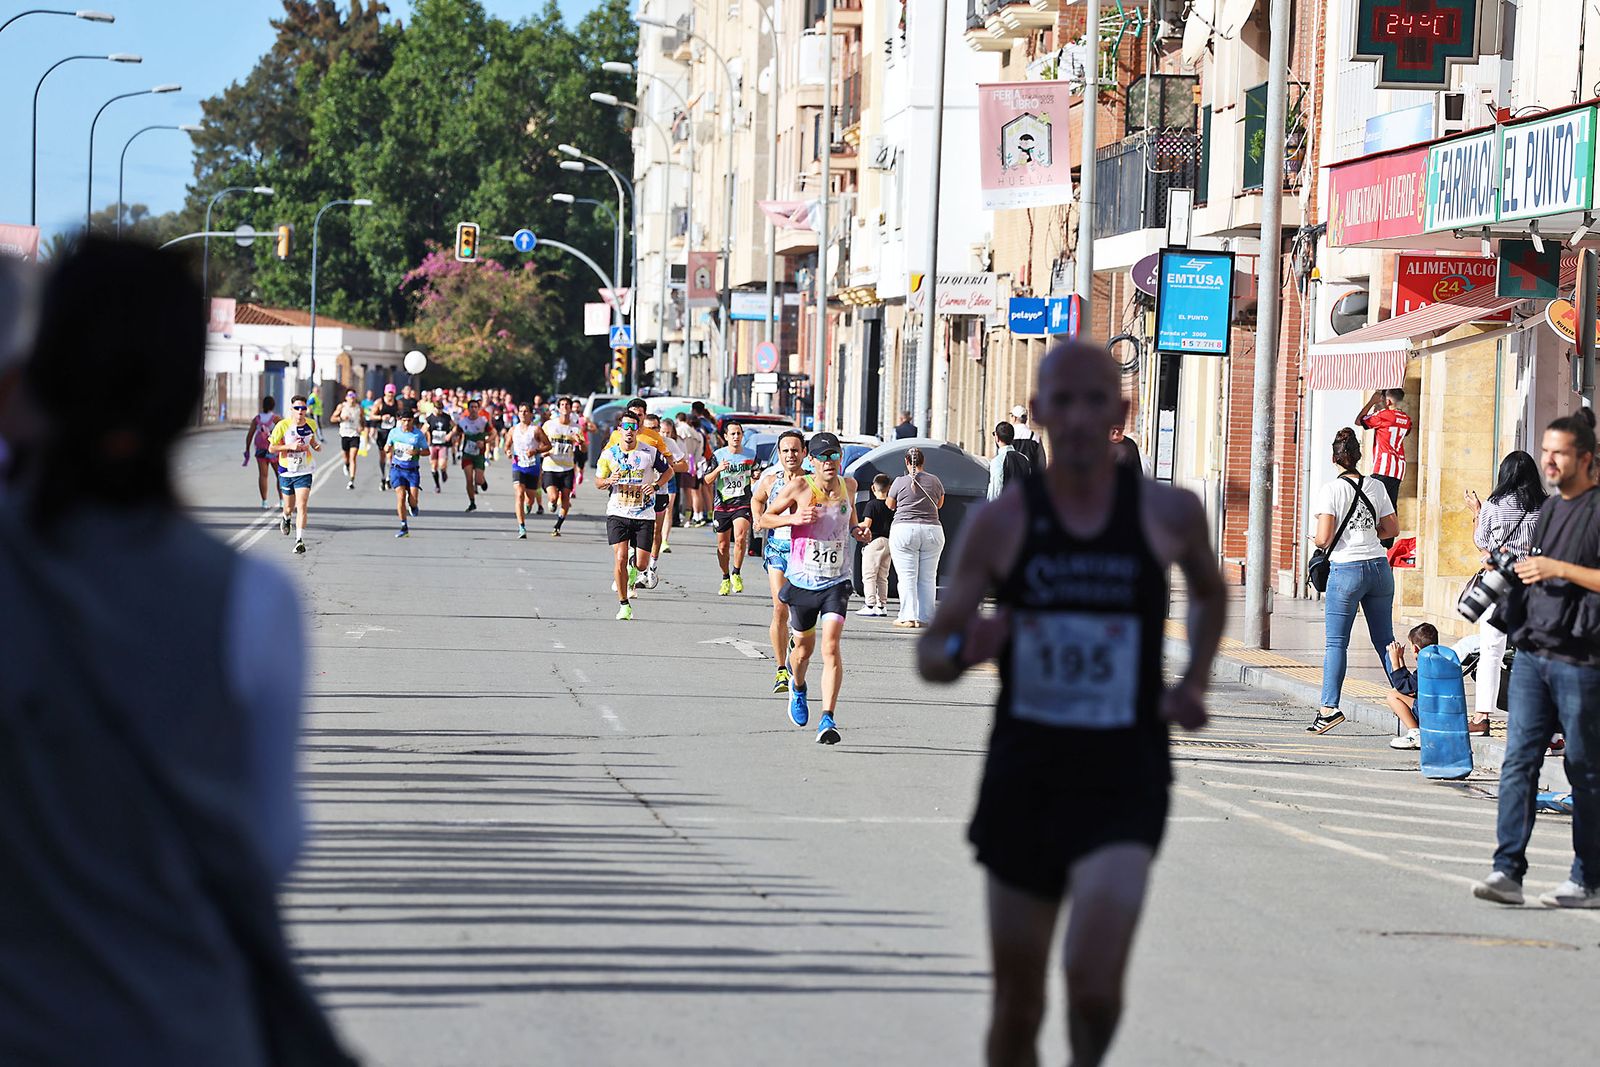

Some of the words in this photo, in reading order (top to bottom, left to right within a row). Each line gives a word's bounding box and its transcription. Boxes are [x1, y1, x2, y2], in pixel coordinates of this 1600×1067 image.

[992, 89, 1021, 101] FERIA
[1011, 99, 1040, 110] LIBRO
[1502, 135, 1518, 213] EL
[1524, 121, 1574, 209] PUNTO
[997, 174, 1054, 186] HUELVA
[1406, 261, 1496, 277] ALIMENTACIÓ
[1167, 273, 1225, 286] EMTUSA
[1438, 281, 1460, 293] 24
[1011, 311, 1038, 322] pelayo
[1556, 320, 1576, 336] NUESTR
[726, 480, 742, 489] 230
[619, 489, 641, 499] 1116
[812, 550, 838, 564] 216
[1041, 643, 1114, 686] 195
